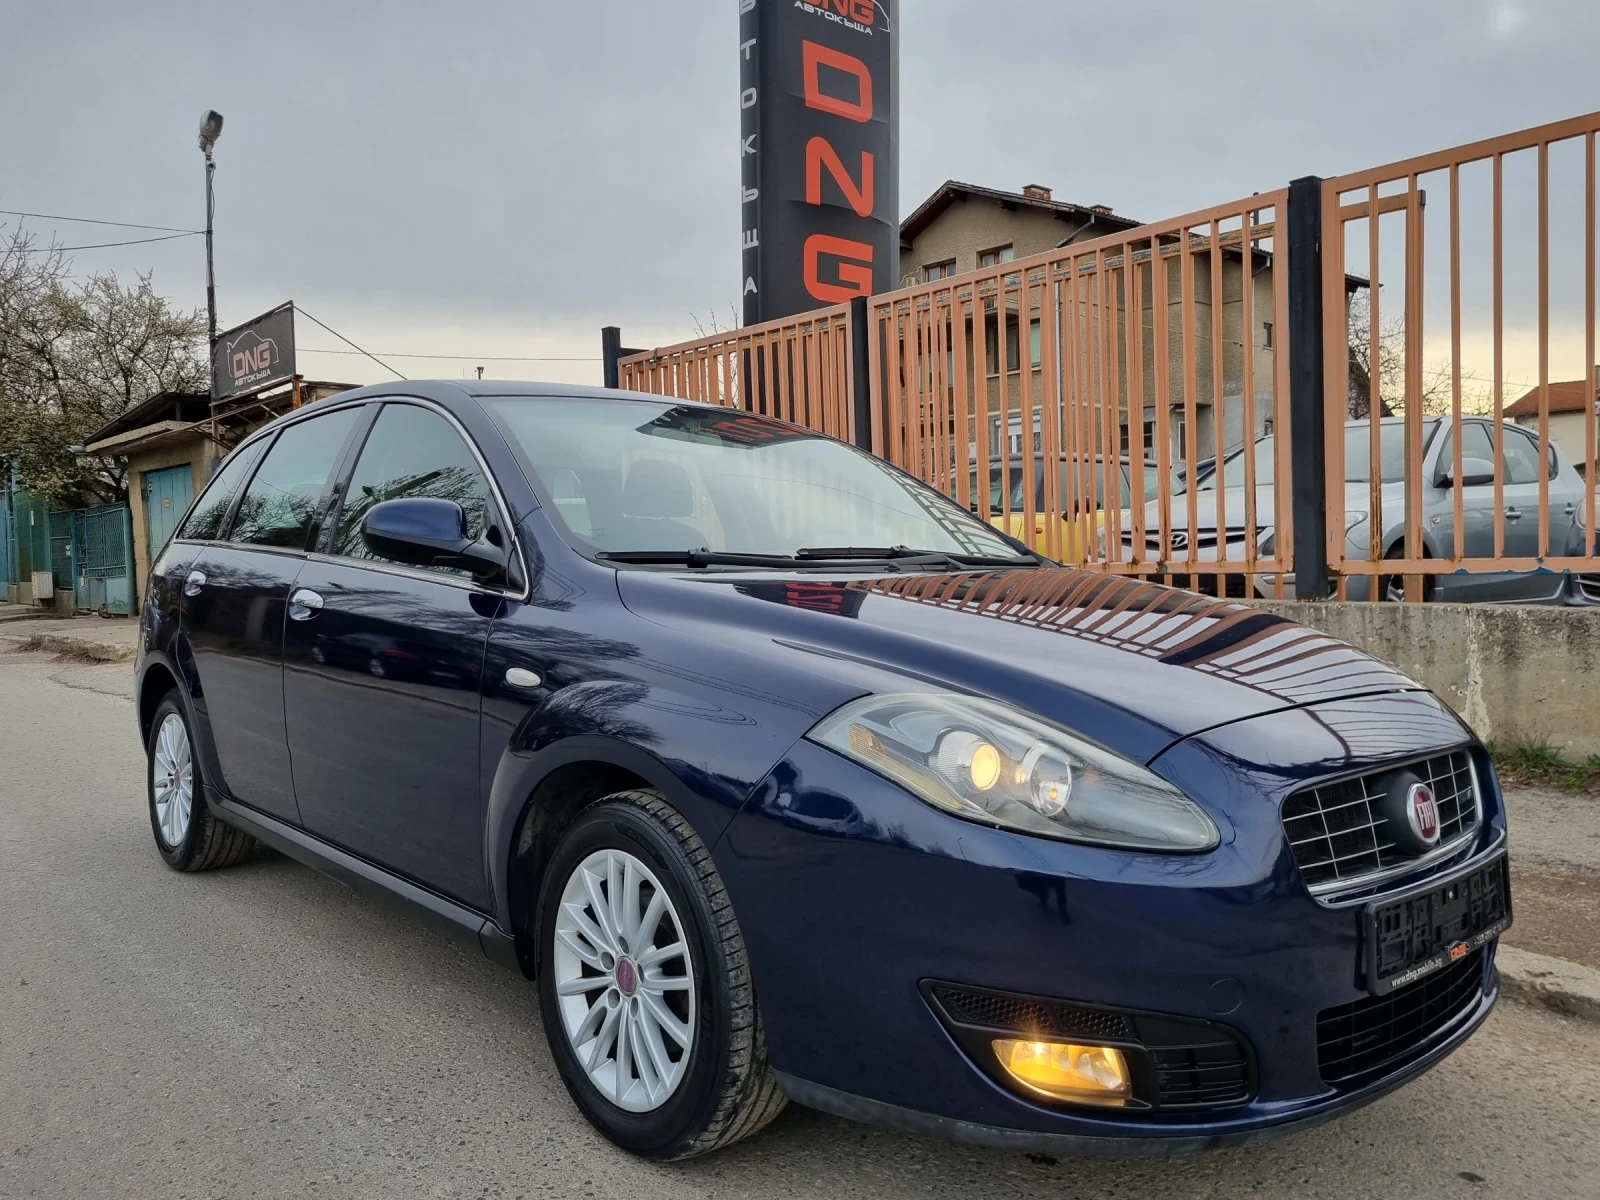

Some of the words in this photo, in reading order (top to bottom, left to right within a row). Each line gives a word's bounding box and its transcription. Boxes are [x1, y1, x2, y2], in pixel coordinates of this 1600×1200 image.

[794, 0, 873, 36] АВТОКЪЩА
[803, 39, 874, 303] DNG
[233, 342, 271, 378] DNG
